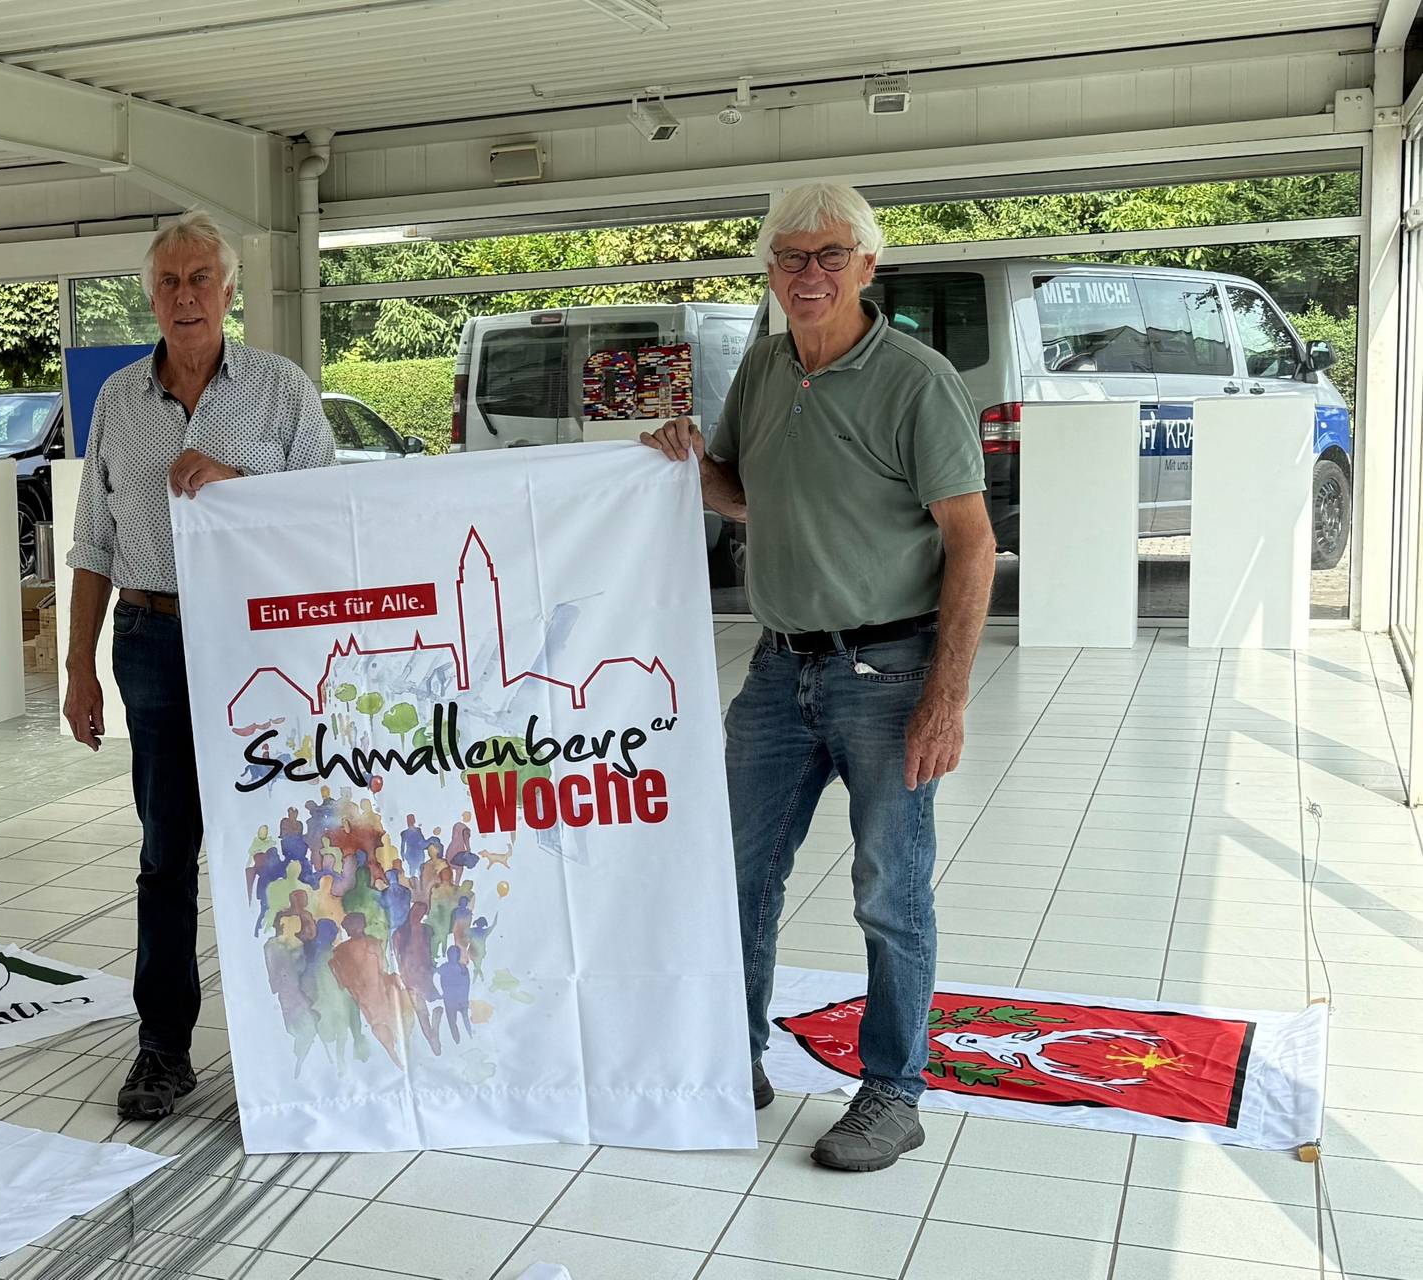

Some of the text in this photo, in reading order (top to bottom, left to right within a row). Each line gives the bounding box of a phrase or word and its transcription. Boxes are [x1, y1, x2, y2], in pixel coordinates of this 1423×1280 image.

[1041, 282, 1131, 304] MIET MICH!
[259, 592, 425, 623] Ein Fest für Alle.
[235, 702, 647, 794] Schmallenberg
[467, 762, 669, 834] Woche
